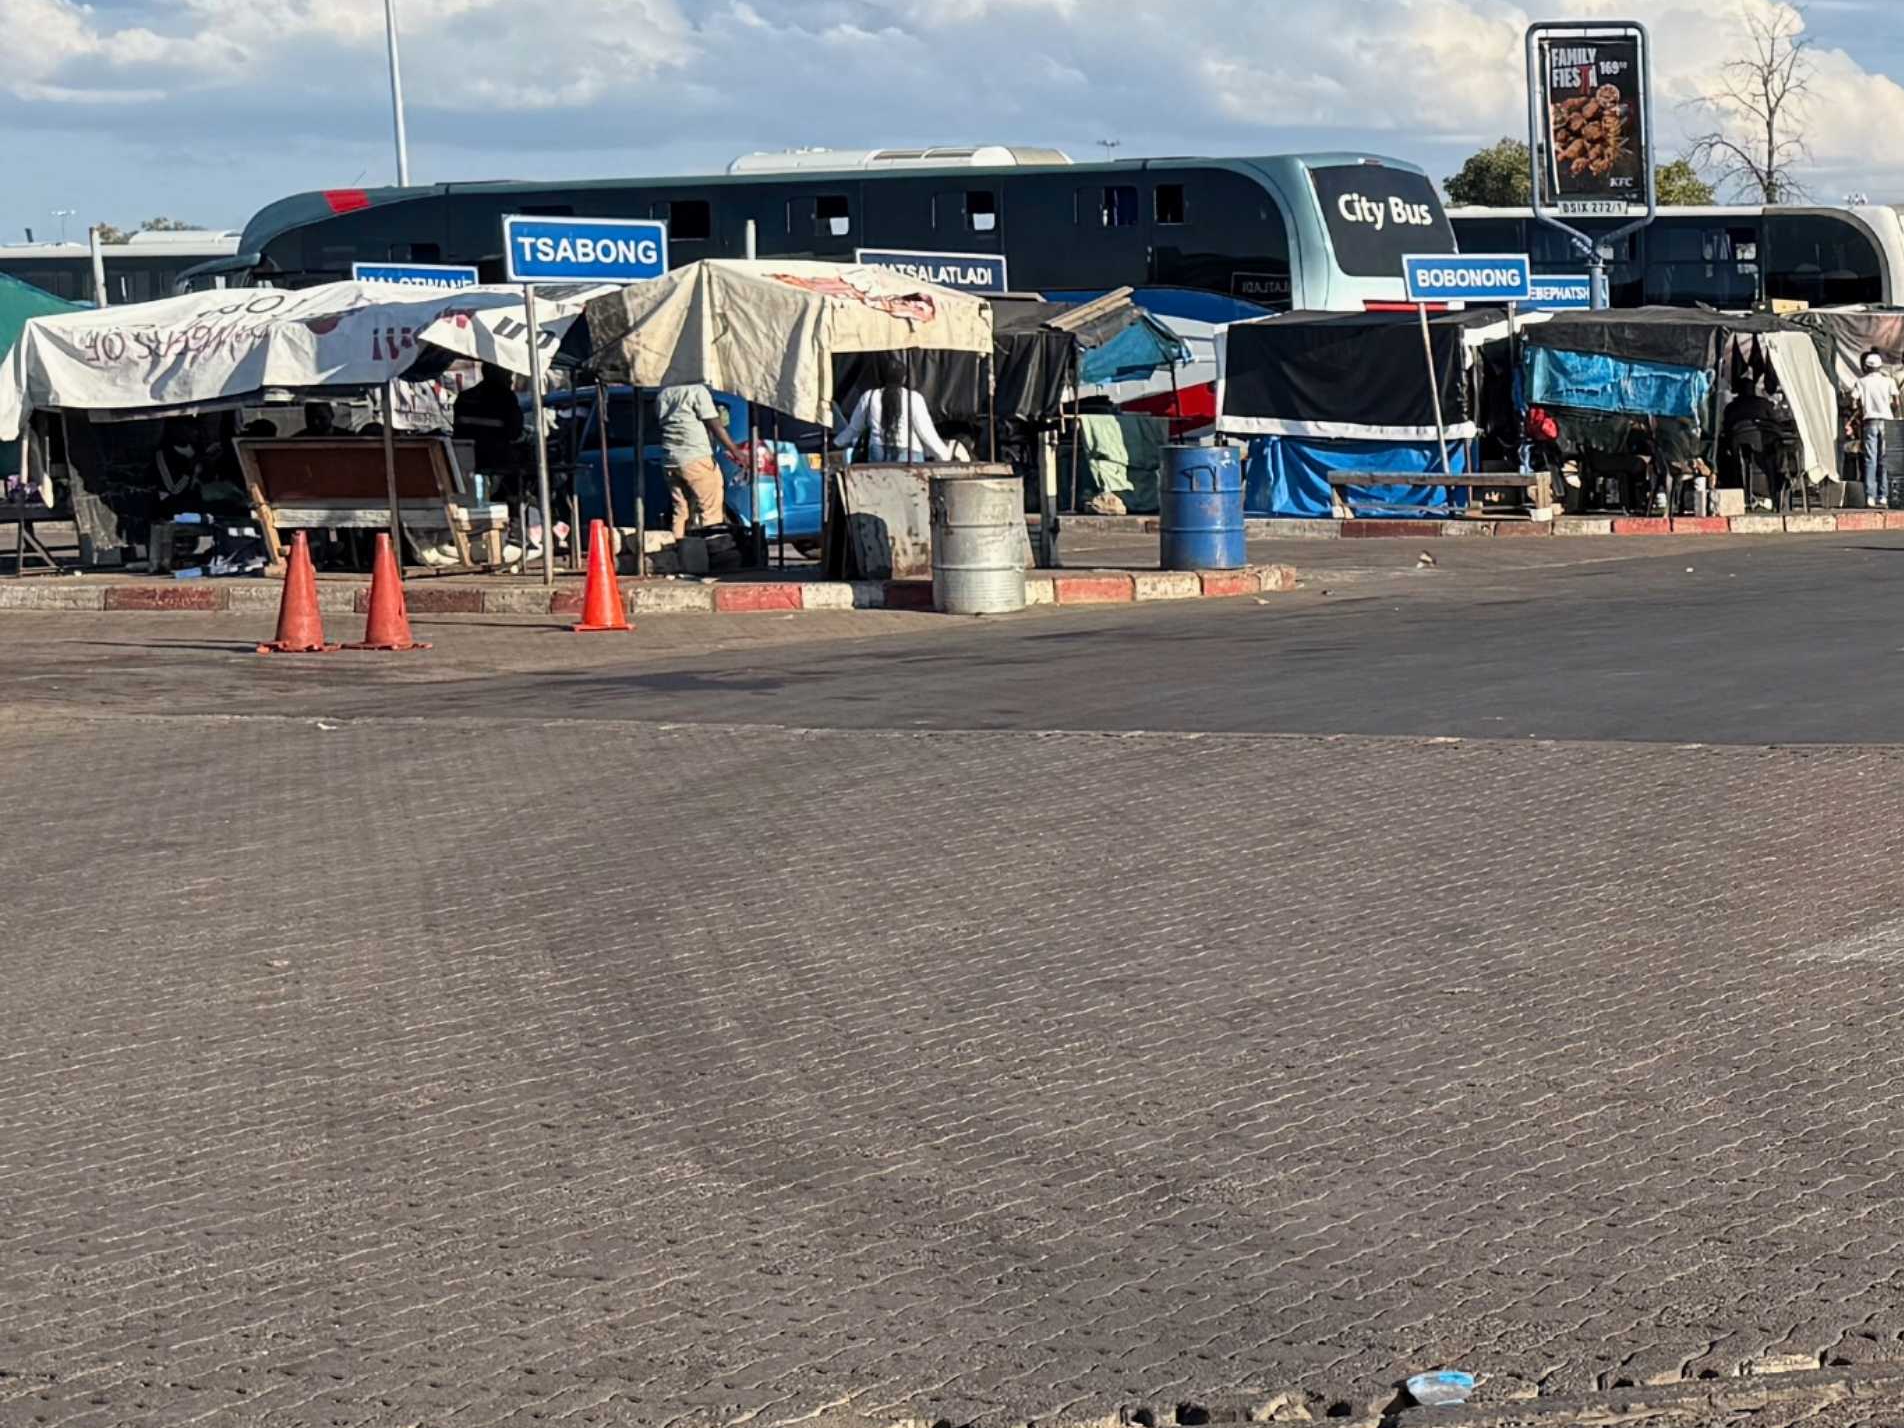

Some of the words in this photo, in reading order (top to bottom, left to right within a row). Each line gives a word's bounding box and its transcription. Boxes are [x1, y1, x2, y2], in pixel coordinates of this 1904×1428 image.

[1551, 48, 1597, 67] FAMILY
[1552, 65, 1598, 92] FIESTA
[1338, 192, 1385, 231] City
[1390, 196, 1433, 227] Bus
[516, 236, 658, 264] TSABONG
[1415, 267, 1522, 288] BOBONONG
